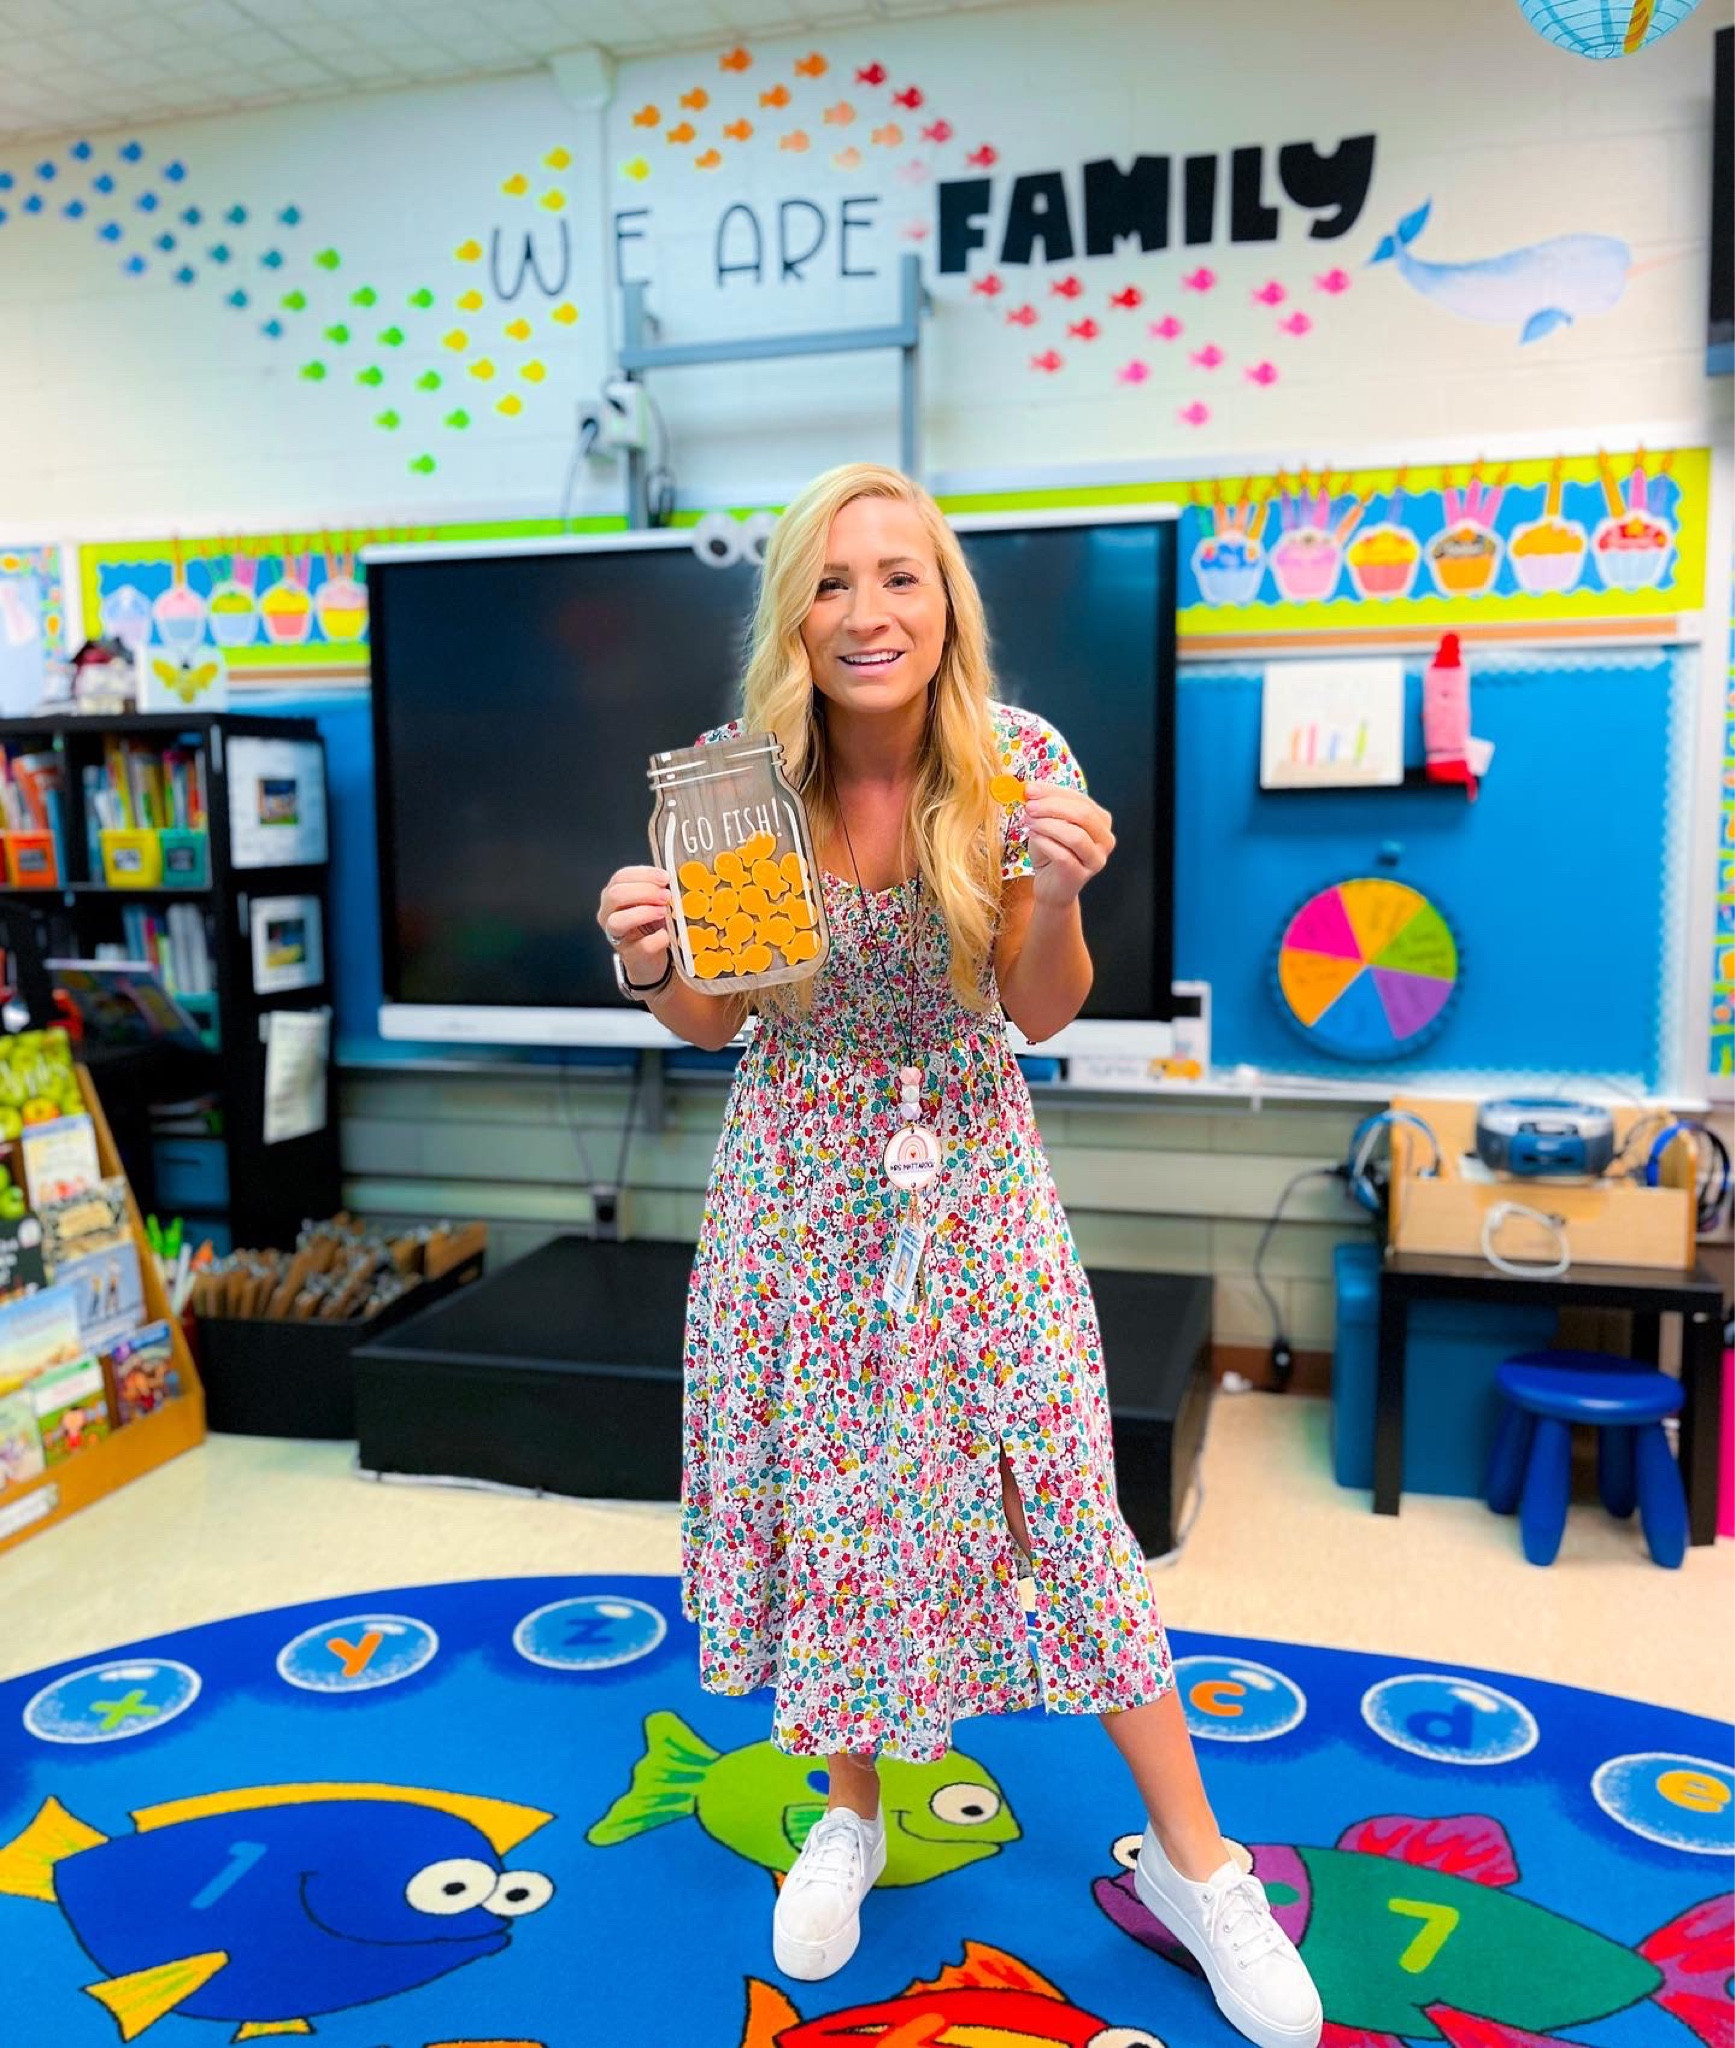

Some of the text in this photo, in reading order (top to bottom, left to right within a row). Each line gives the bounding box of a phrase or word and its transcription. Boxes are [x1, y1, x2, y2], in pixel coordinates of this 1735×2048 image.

[716, 195, 880, 288] ARE
[937, 134, 1377, 274] FAMILY
[681, 796, 783, 854] GO FISH!
[1406, 1704, 1475, 1748] d
[1657, 1770, 1732, 1813] e
[190, 1840, 268, 1910] 1
[1387, 1898, 1460, 1975] 7
